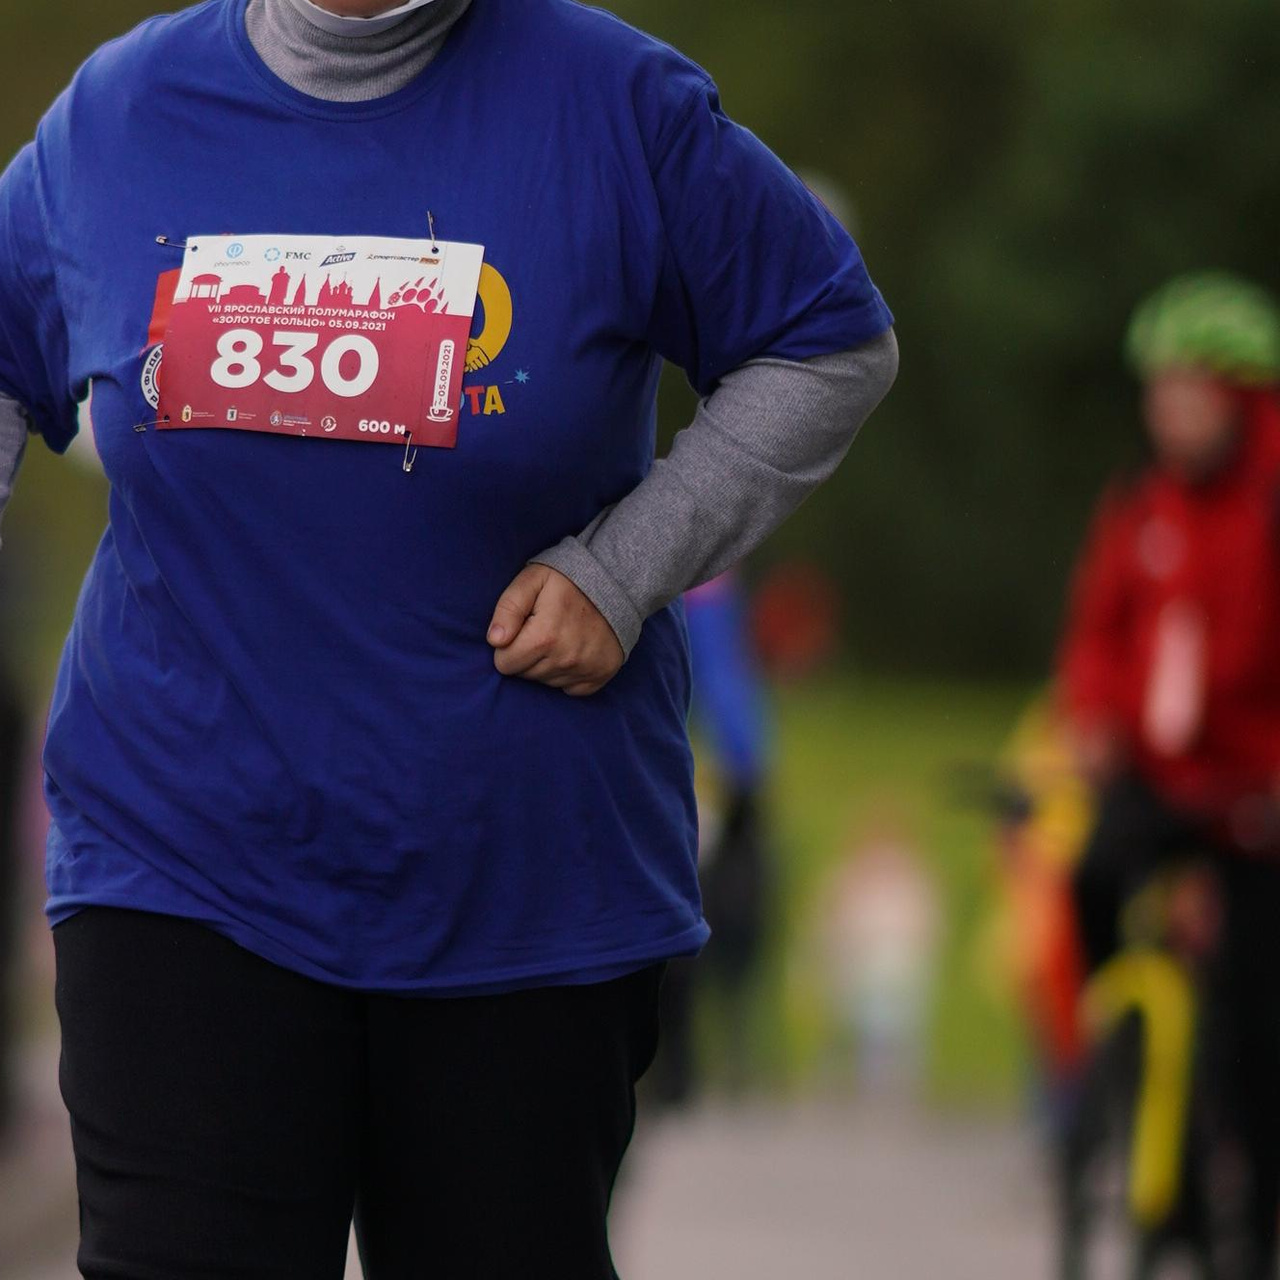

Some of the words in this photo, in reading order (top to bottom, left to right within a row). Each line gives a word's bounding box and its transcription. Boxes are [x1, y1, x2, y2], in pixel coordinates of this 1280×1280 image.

[285, 251, 312, 261] FMC
[325, 253, 353, 265] Active
[207, 304, 221, 314] VII
[224, 304, 305, 316] ЯРОСЛАВСКИЙ
[307, 307, 396, 321] ПОЛУМАРАФОН
[212, 315, 271, 325] «ЗОЛОТОЕ
[273, 317, 326, 328] КОЛЬЦО»
[328, 320, 386, 332] 05.09.2021
[210, 328, 380, 398] 830
[460, 385, 506, 416] ТА
[358, 420, 390, 434] 600
